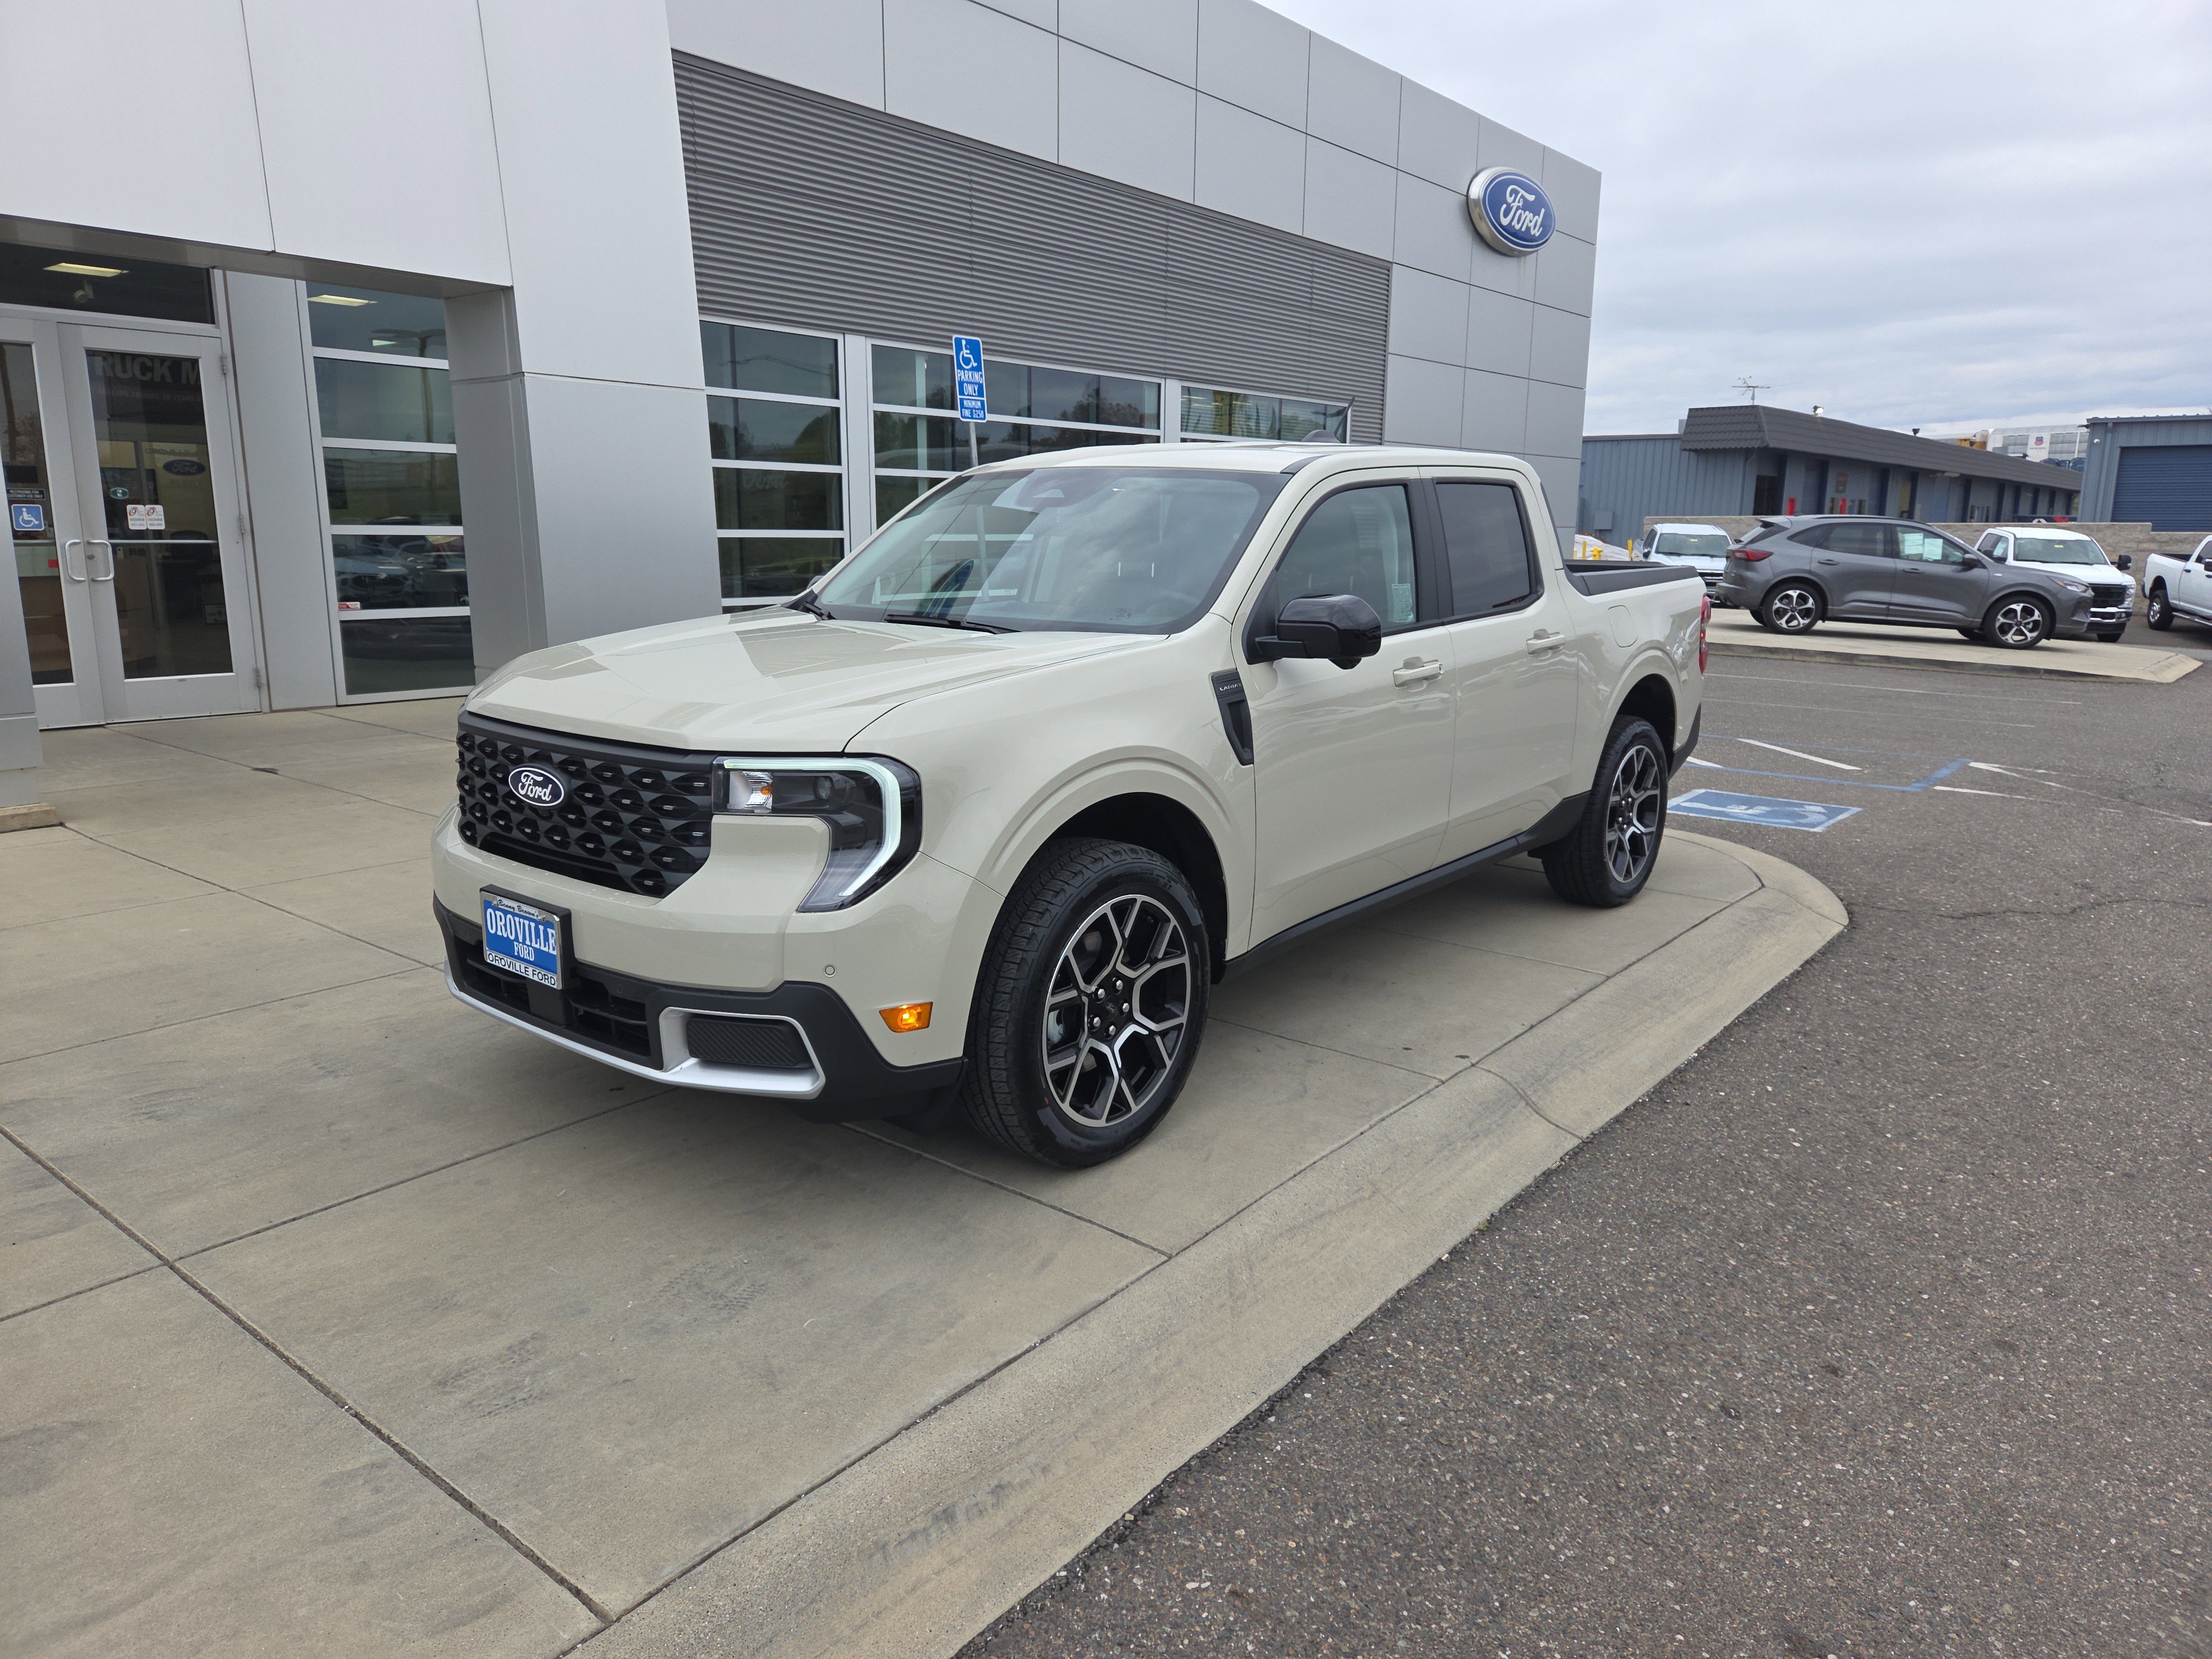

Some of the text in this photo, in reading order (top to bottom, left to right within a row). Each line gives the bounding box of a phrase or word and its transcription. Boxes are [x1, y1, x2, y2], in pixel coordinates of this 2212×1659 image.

[1500, 185, 1545, 237] Ford
[957, 369, 983, 384] PARKING
[963, 383, 979, 396] ONLY
[962, 408, 971, 417] FINE
[518, 771, 552, 802] Ford
[486, 908, 557, 956] OROVILLE
[513, 941, 535, 961] FORD
[488, 953, 556, 986] OROVILLE FORD
